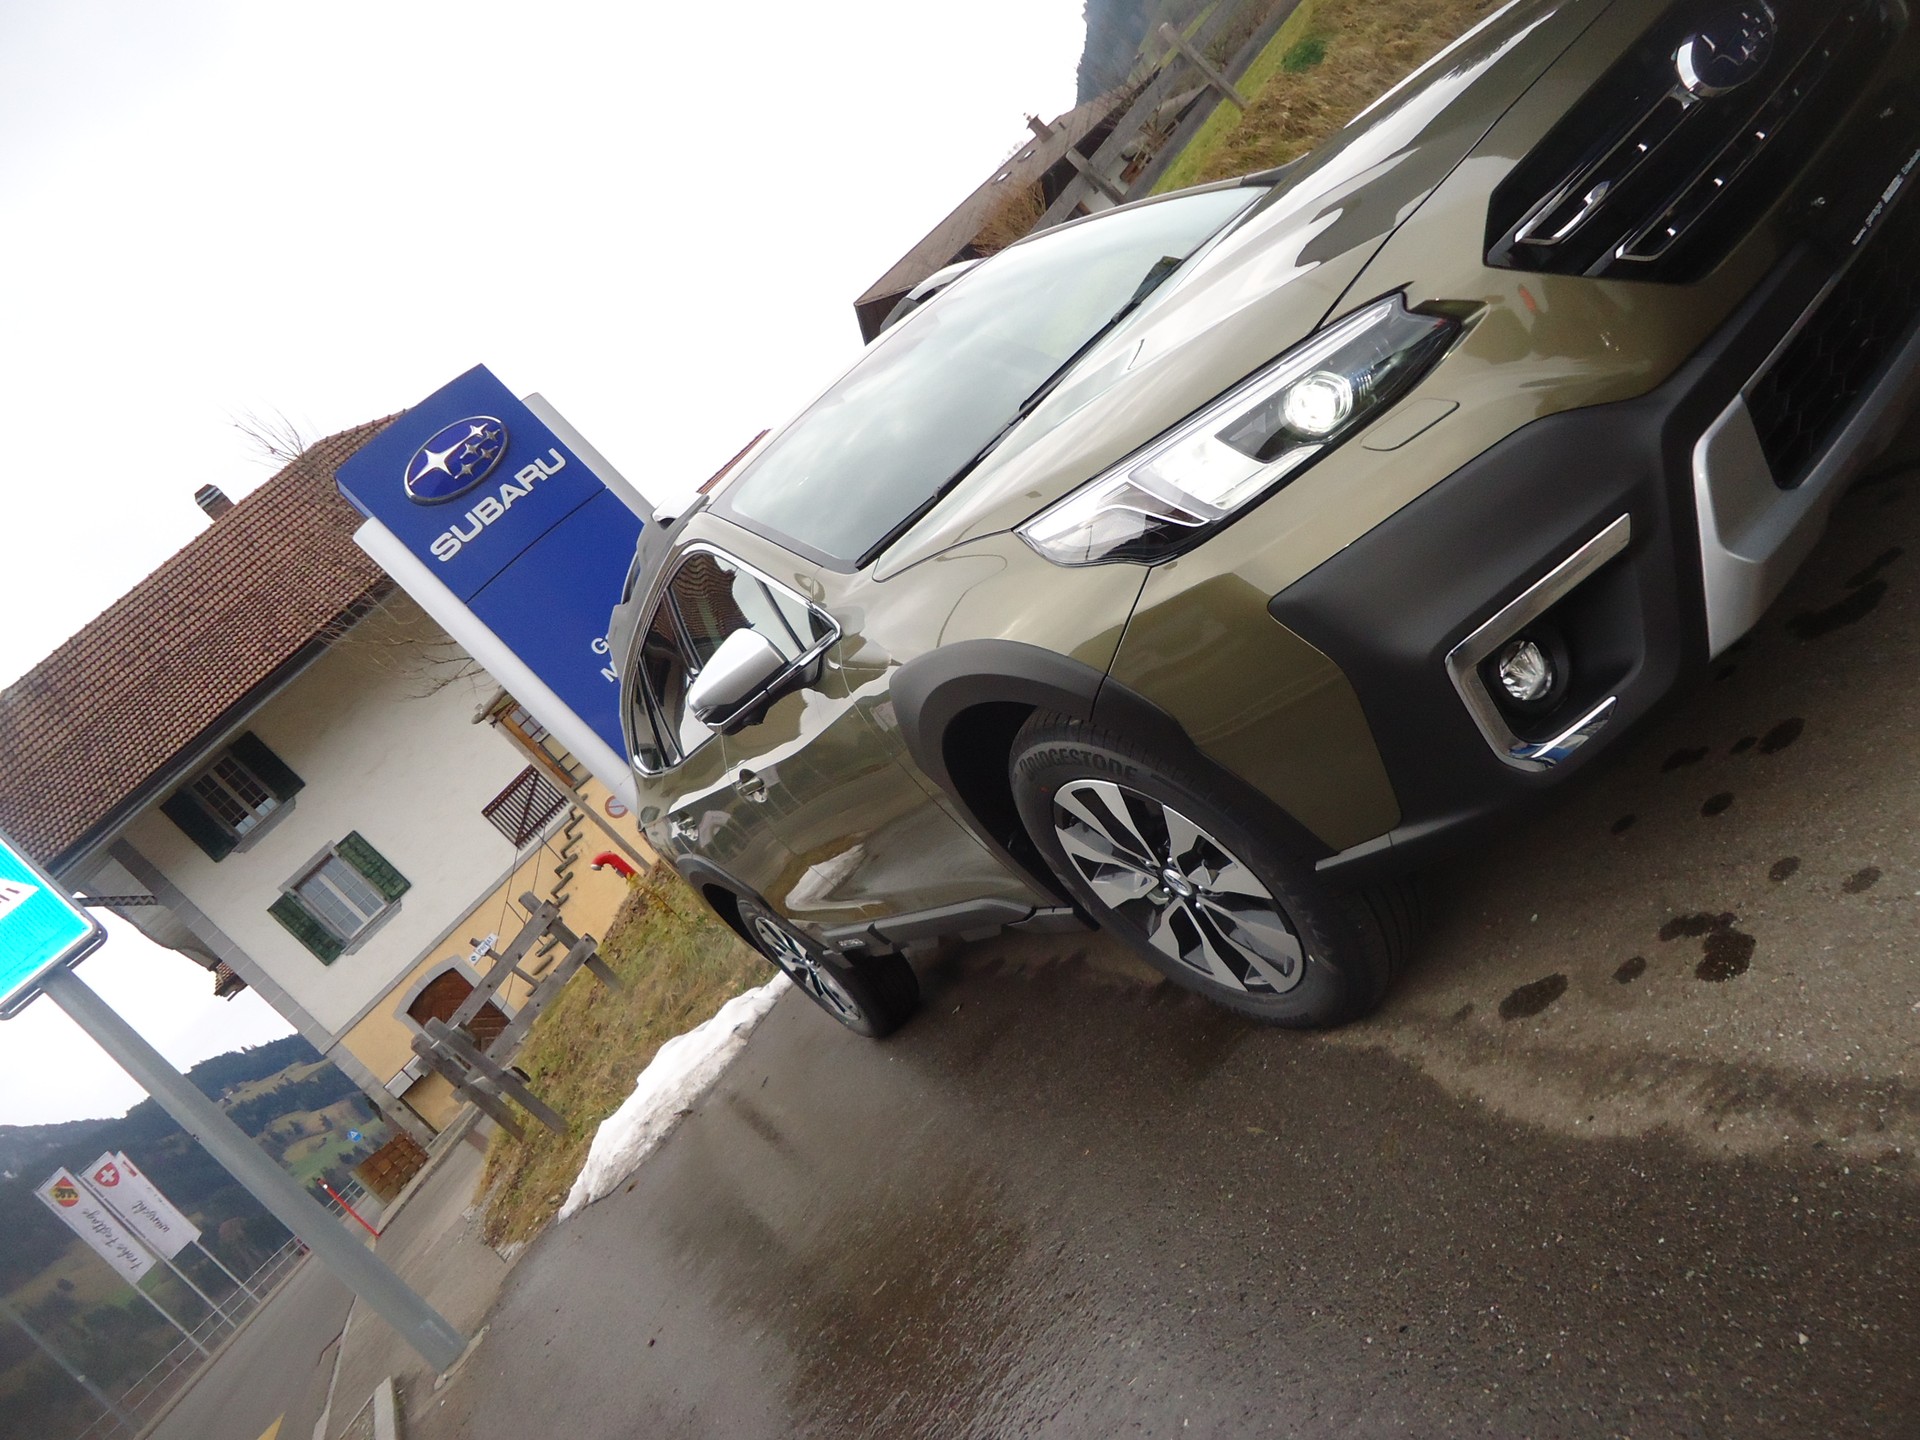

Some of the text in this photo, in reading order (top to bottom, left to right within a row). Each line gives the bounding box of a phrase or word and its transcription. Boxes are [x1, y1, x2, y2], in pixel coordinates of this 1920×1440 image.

[430, 448, 566, 562] SUBARU
[591, 633, 609, 655] G
[1018, 748, 1138, 781] BRIDGESTONE
